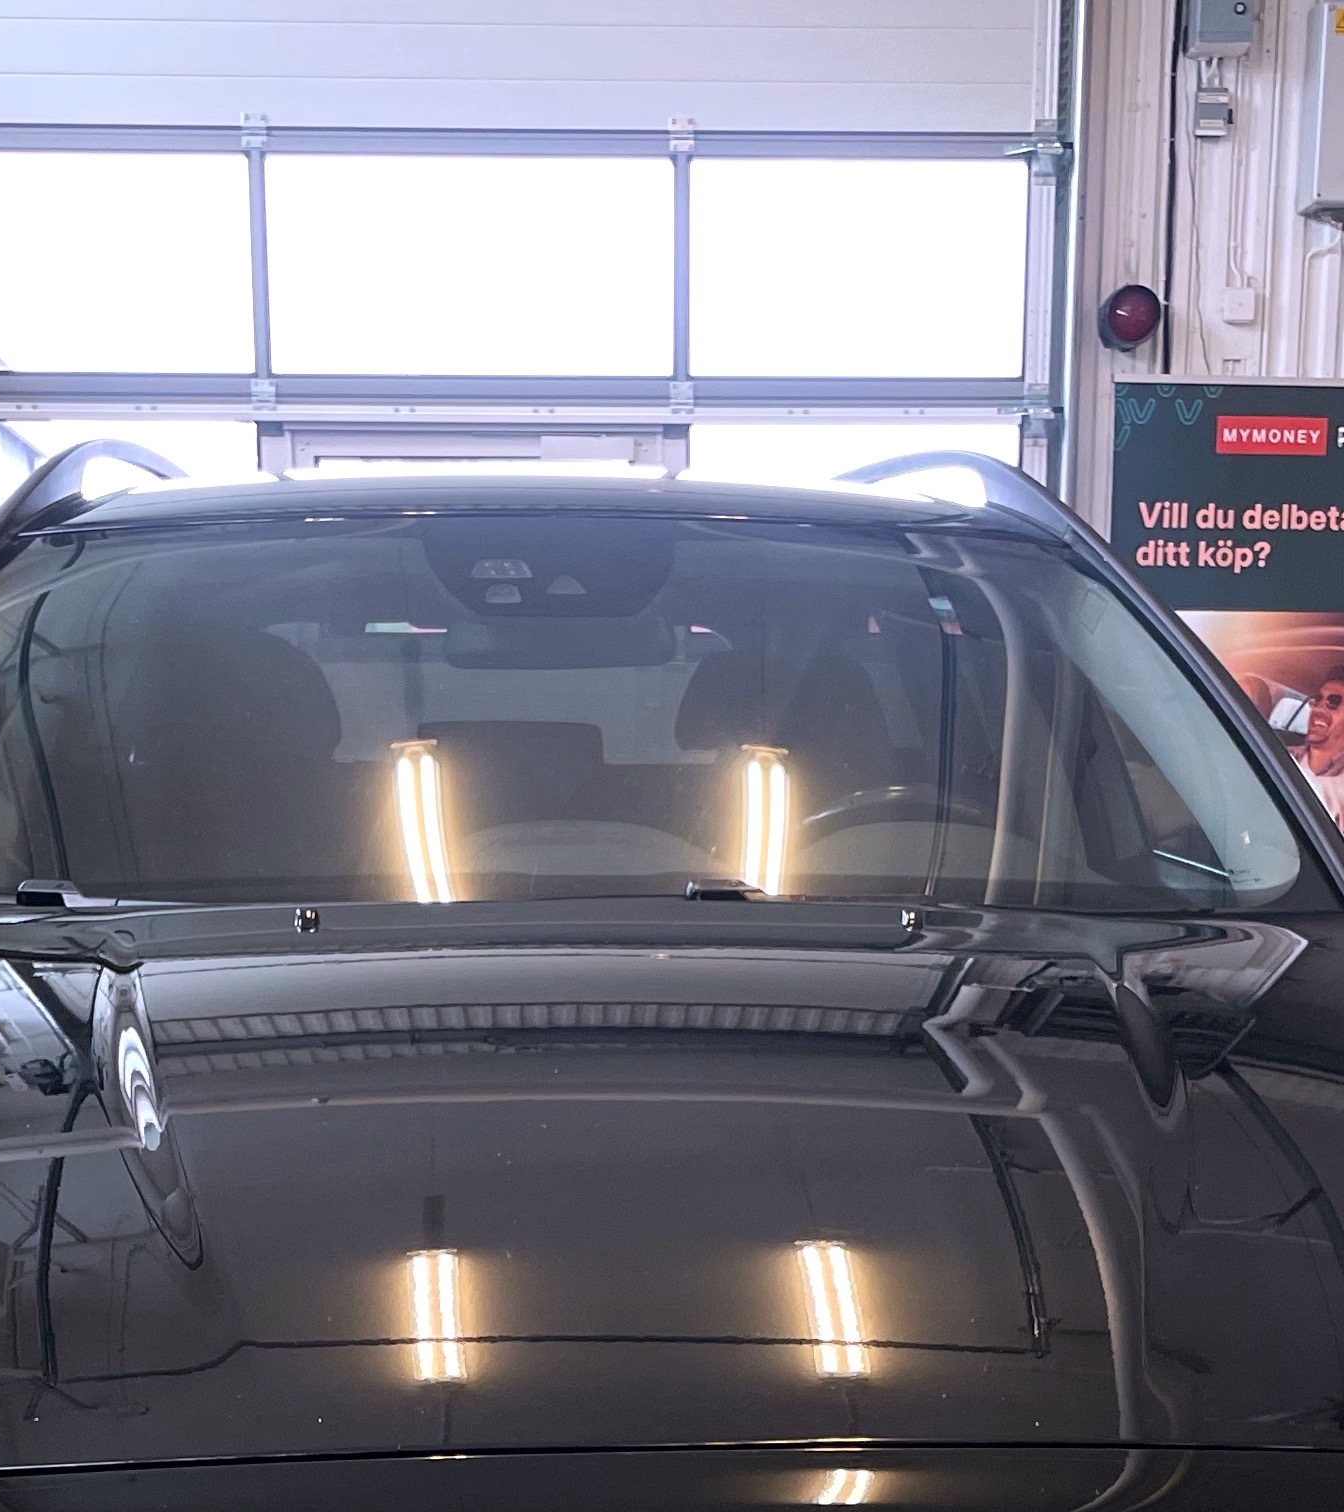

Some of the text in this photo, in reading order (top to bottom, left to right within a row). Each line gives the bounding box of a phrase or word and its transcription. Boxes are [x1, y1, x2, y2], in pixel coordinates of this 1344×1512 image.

[1222, 428, 1321, 444] MYMONEY
[1138, 501, 1188, 529] Vill
[1195, 503, 1234, 530] du
[1135, 540, 1272, 574] ditt köp?
